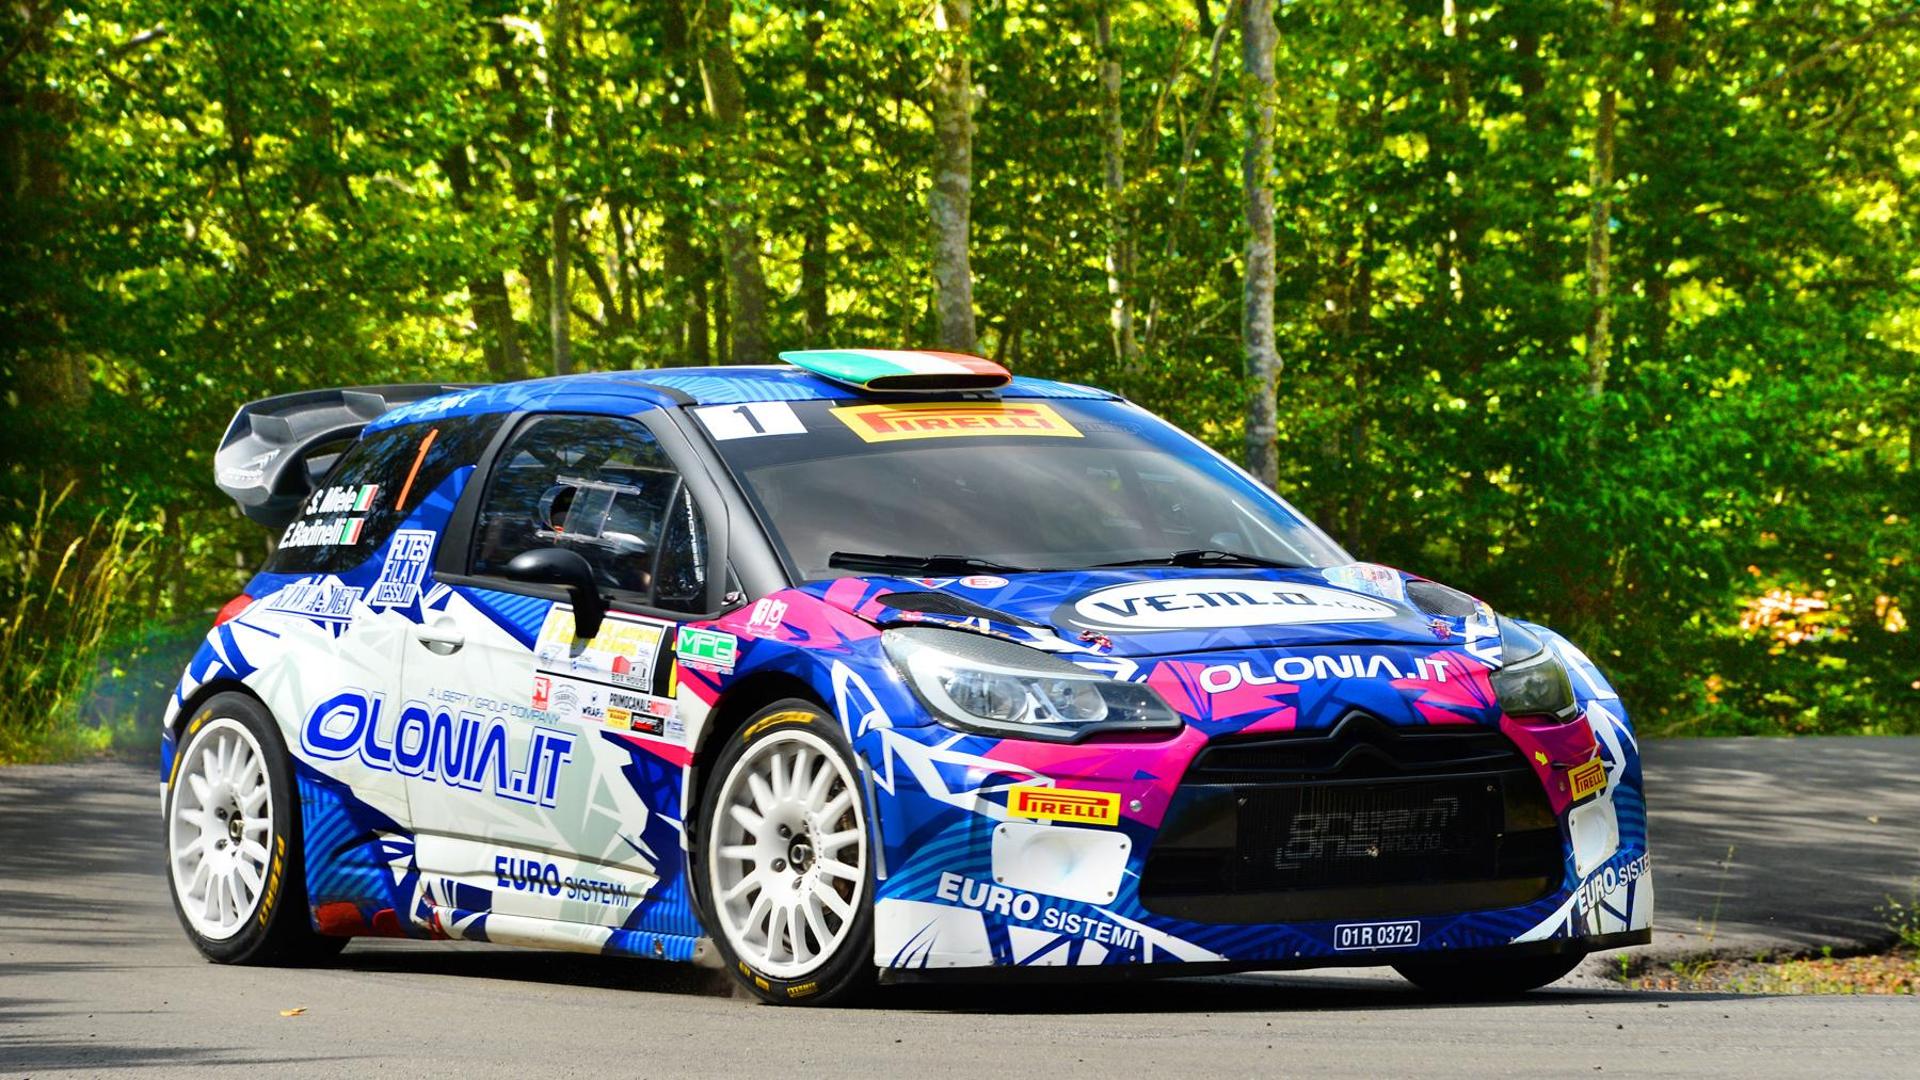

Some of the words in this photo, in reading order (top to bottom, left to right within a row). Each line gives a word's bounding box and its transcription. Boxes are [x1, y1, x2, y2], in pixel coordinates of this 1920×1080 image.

[733, 406, 766, 433] 1
[857, 407, 1054, 433] PIRELLI
[395, 429, 438, 511] 1
[306, 489, 323, 515] S.
[318, 486, 357, 513] Miele
[679, 630, 734, 662] MPG
[1199, 655, 1449, 693] OLONIA.IT
[436, 691, 474, 706] LIBERTY
[475, 697, 510, 713] GROUP
[511, 704, 560, 725] COMPANY
[302, 687, 575, 806] OLONIA.IT
[1574, 763, 1604, 794] PIRELLI
[1018, 792, 1110, 818] PIRELLI
[495, 855, 561, 896] EURO
[565, 876, 629, 908] SISTEMI
[1577, 866, 1617, 916] EURO
[936, 871, 1040, 921] EURO
[1043, 907, 1139, 949] SISTEMI
[1377, 925, 1413, 944] 0372
